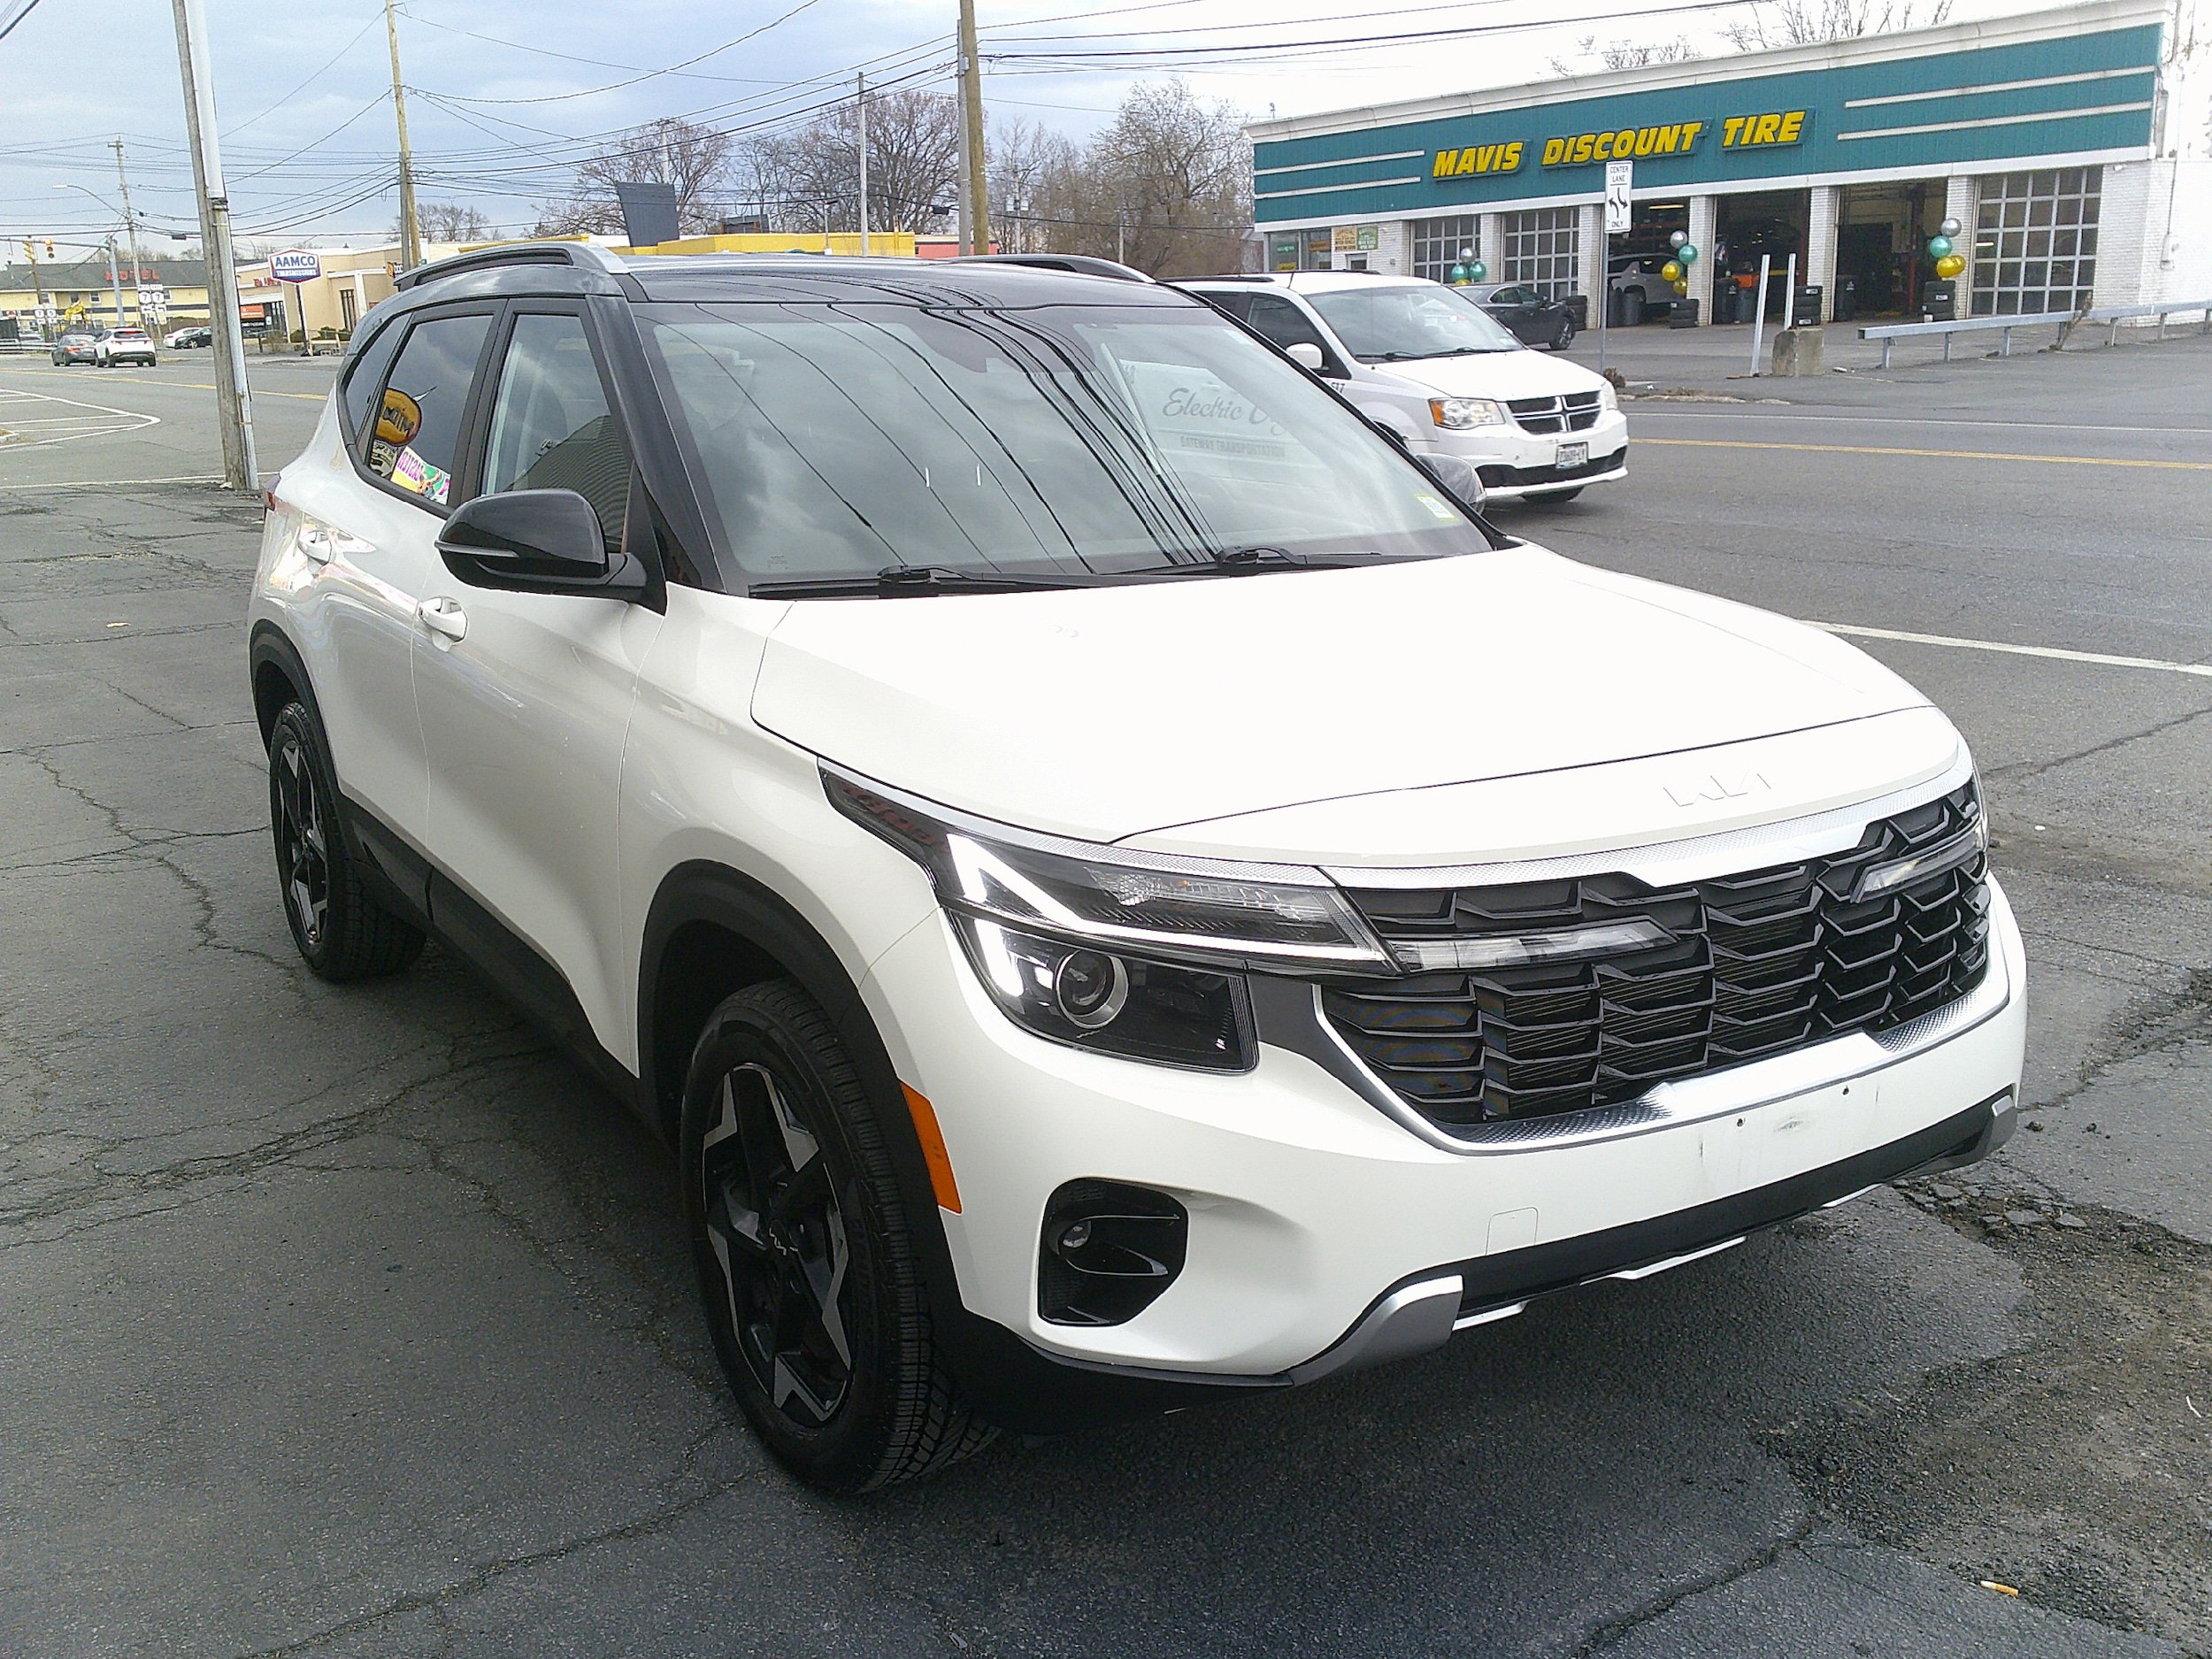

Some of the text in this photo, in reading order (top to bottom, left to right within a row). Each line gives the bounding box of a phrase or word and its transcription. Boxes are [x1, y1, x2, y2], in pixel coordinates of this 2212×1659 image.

[1432, 111, 1807, 179] MAVIS DISCOUNT TIRE
[1609, 165, 1629, 174] CENTER
[275, 256, 316, 267] AAMCO
[1163, 388, 1243, 419] Electric
